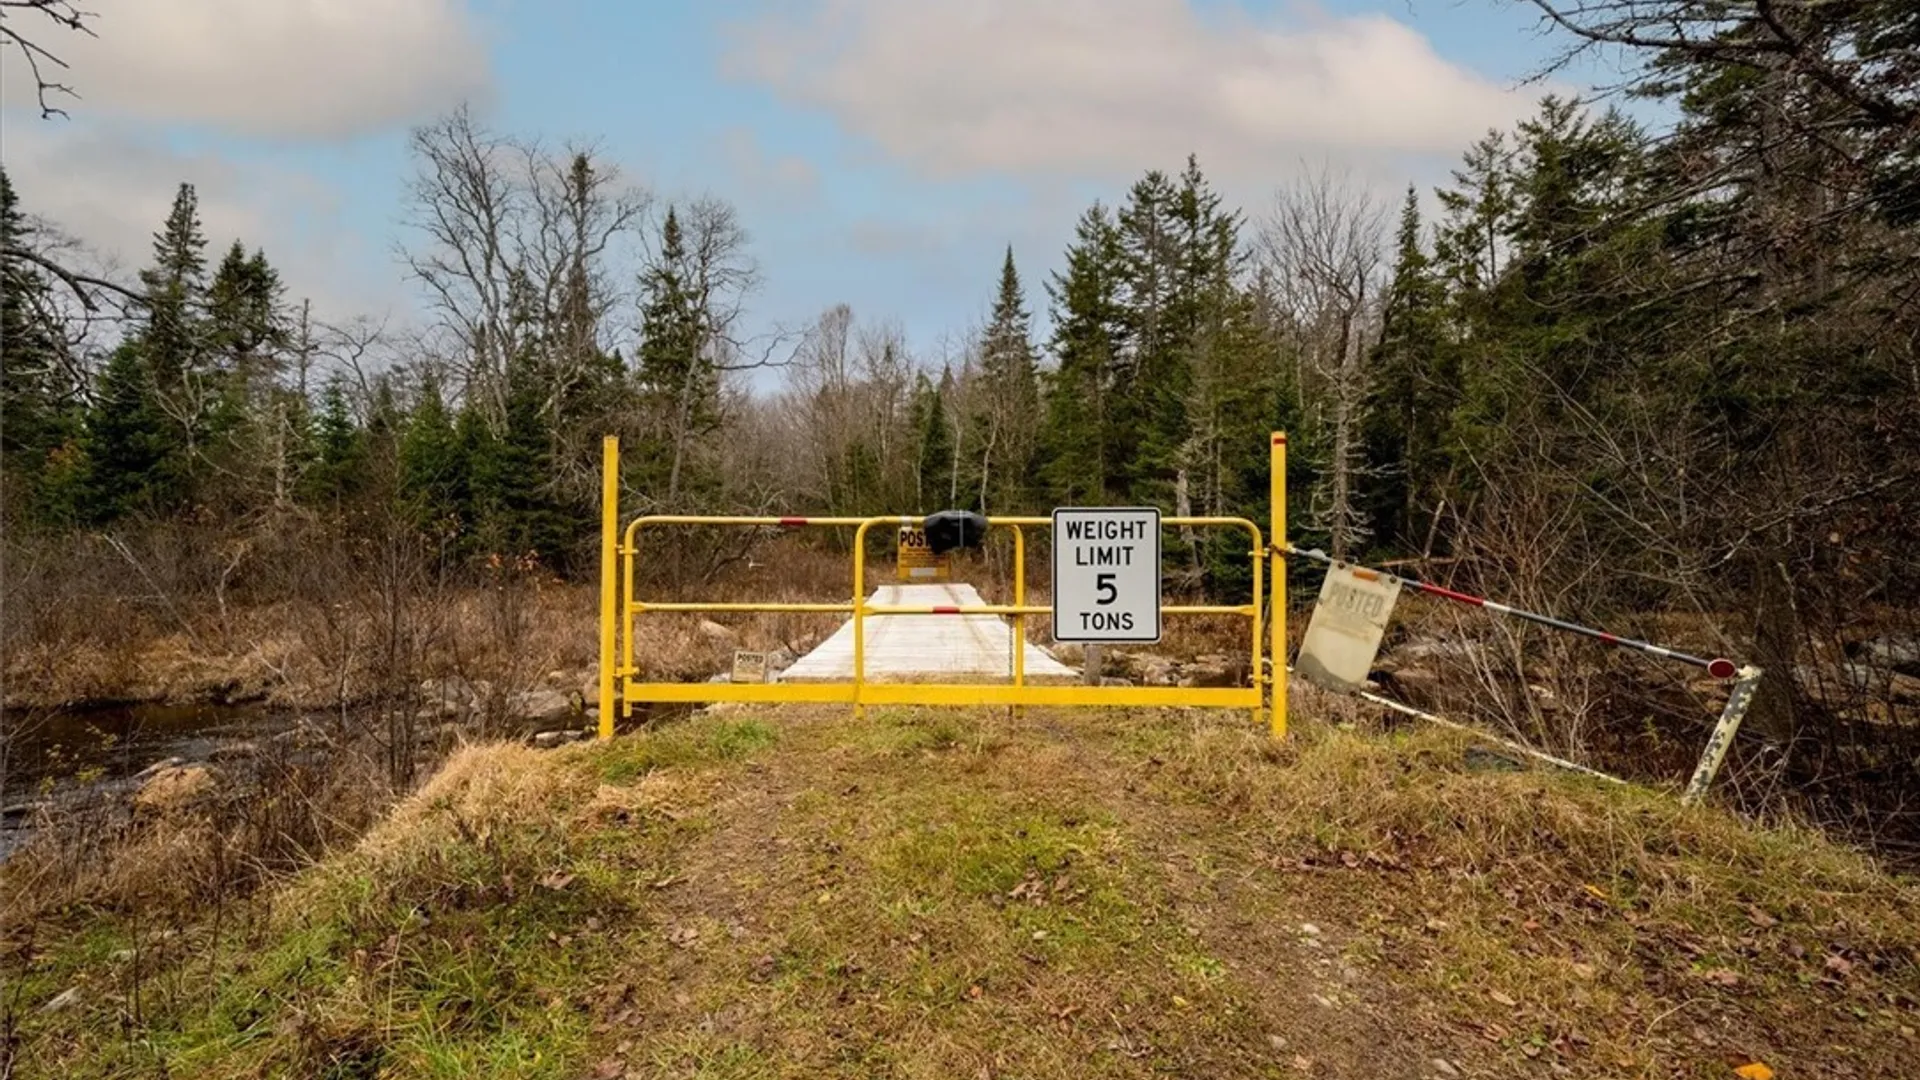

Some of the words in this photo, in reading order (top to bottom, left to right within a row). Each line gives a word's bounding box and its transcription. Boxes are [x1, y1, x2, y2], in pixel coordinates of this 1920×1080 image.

[900, 531, 930, 547] POST
[1066, 521, 1147, 540] WEIGHT
[1076, 546, 1134, 566] LIMIT
[1096, 573, 1118, 606] 5
[1328, 582, 1384, 619] POSTED
[1079, 612, 1134, 630] TONS
